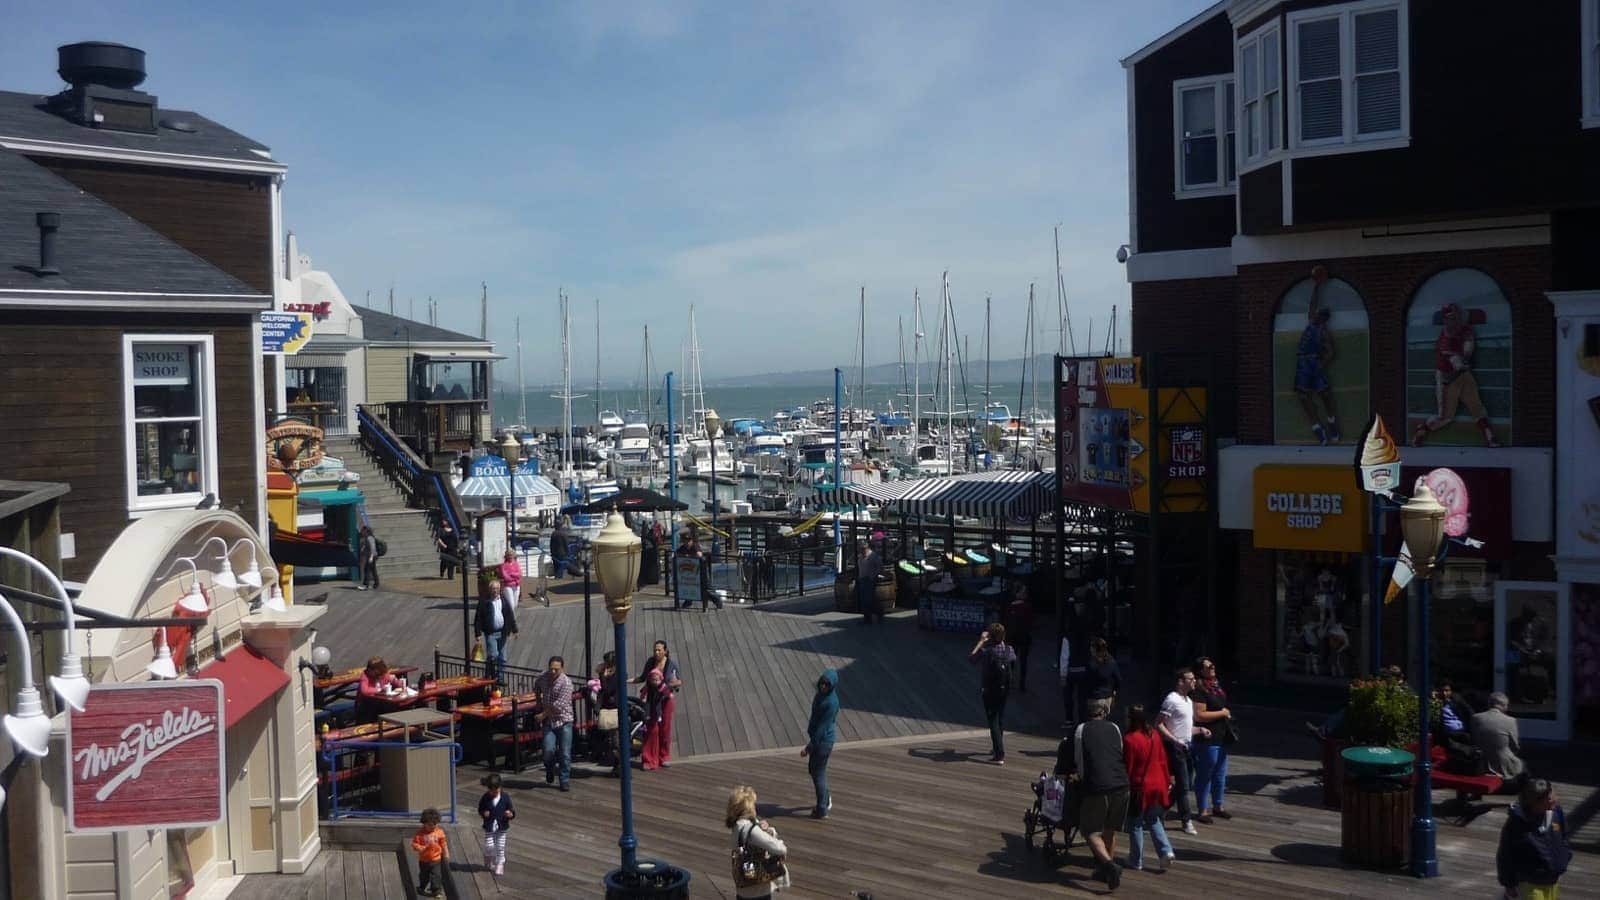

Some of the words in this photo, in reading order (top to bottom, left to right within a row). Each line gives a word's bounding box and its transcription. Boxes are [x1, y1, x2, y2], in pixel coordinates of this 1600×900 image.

[135, 352, 185, 362] SMOKE
[143, 366, 179, 377] SHOP
[1173, 443, 1201, 461] NFL
[475, 466, 507, 476] BOAT
[1169, 465, 1207, 478] SHOP
[1267, 493, 1342, 513] COLLEGE
[1286, 514, 1322, 528] SHOP
